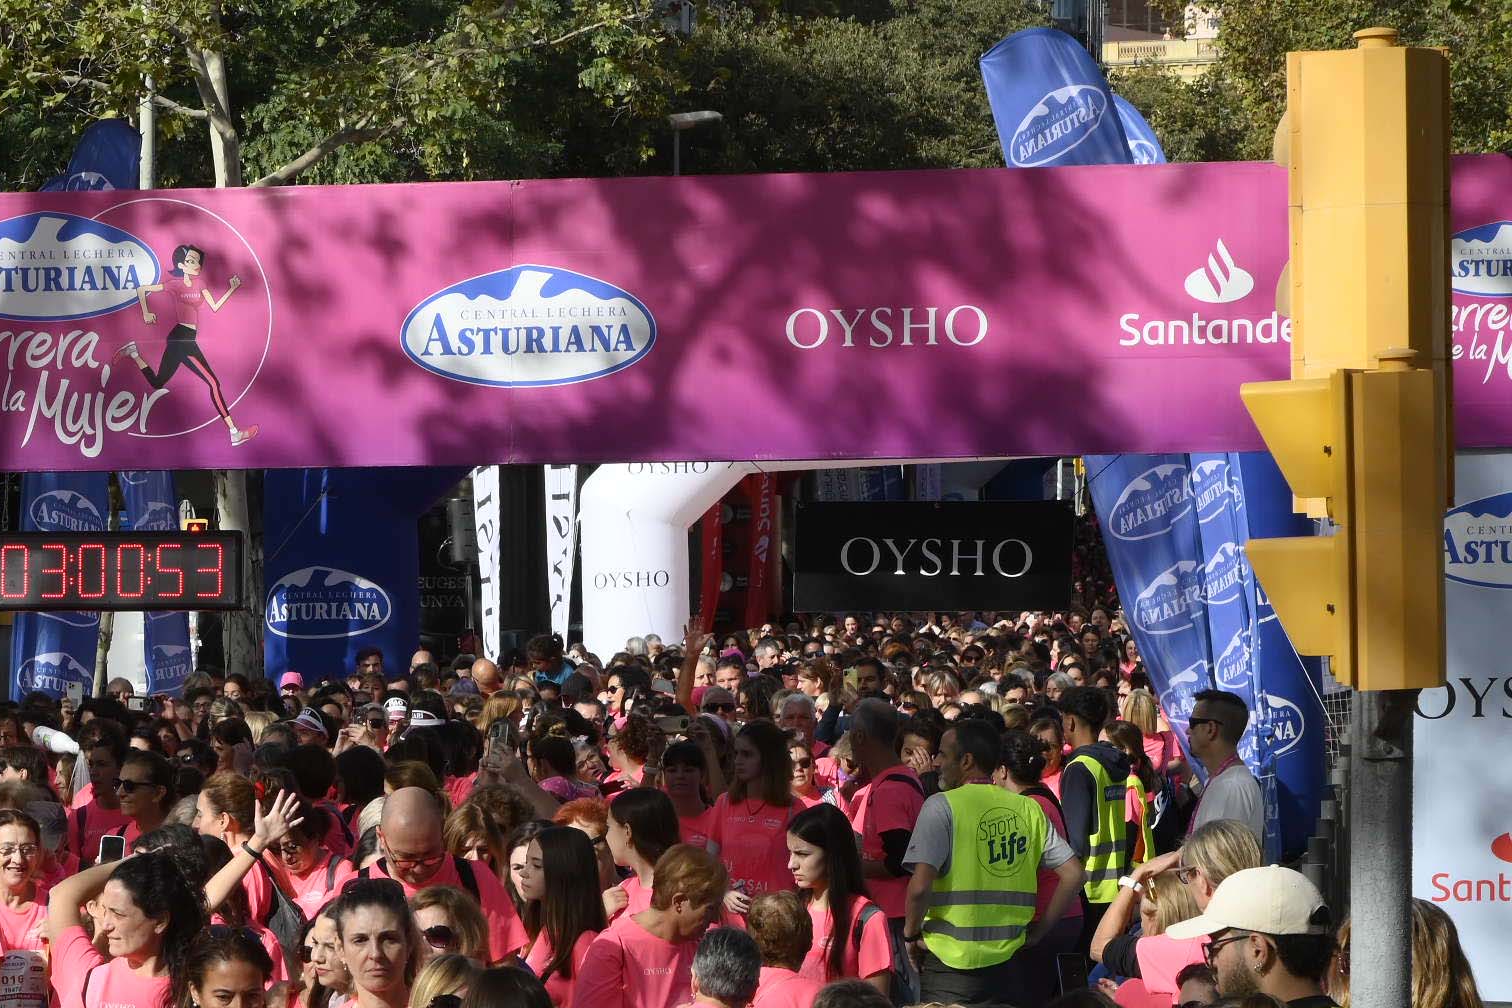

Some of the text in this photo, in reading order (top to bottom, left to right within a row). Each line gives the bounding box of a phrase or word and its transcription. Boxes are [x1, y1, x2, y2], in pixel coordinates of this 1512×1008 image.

[64, 247, 136, 260] LECHERA
[460, 305, 628, 320] CENTRAL LECHERA
[786, 305, 989, 349] OYSHO
[1119, 312, 1292, 347] Santande
[420, 311, 637, 357] ASTURIANA
[1469, 333, 1487, 360] la
[1, 373, 26, 412] la
[21, 364, 170, 458] Mujer
[1, 543, 223, 598] 03:00:53
[840, 537, 1032, 578] OYSHO
[594, 569, 670, 590] OYSHO
[270, 595, 382, 624] ASTURIANA
[979, 814, 1019, 841] Sport
[988, 831, 1027, 866] Life
